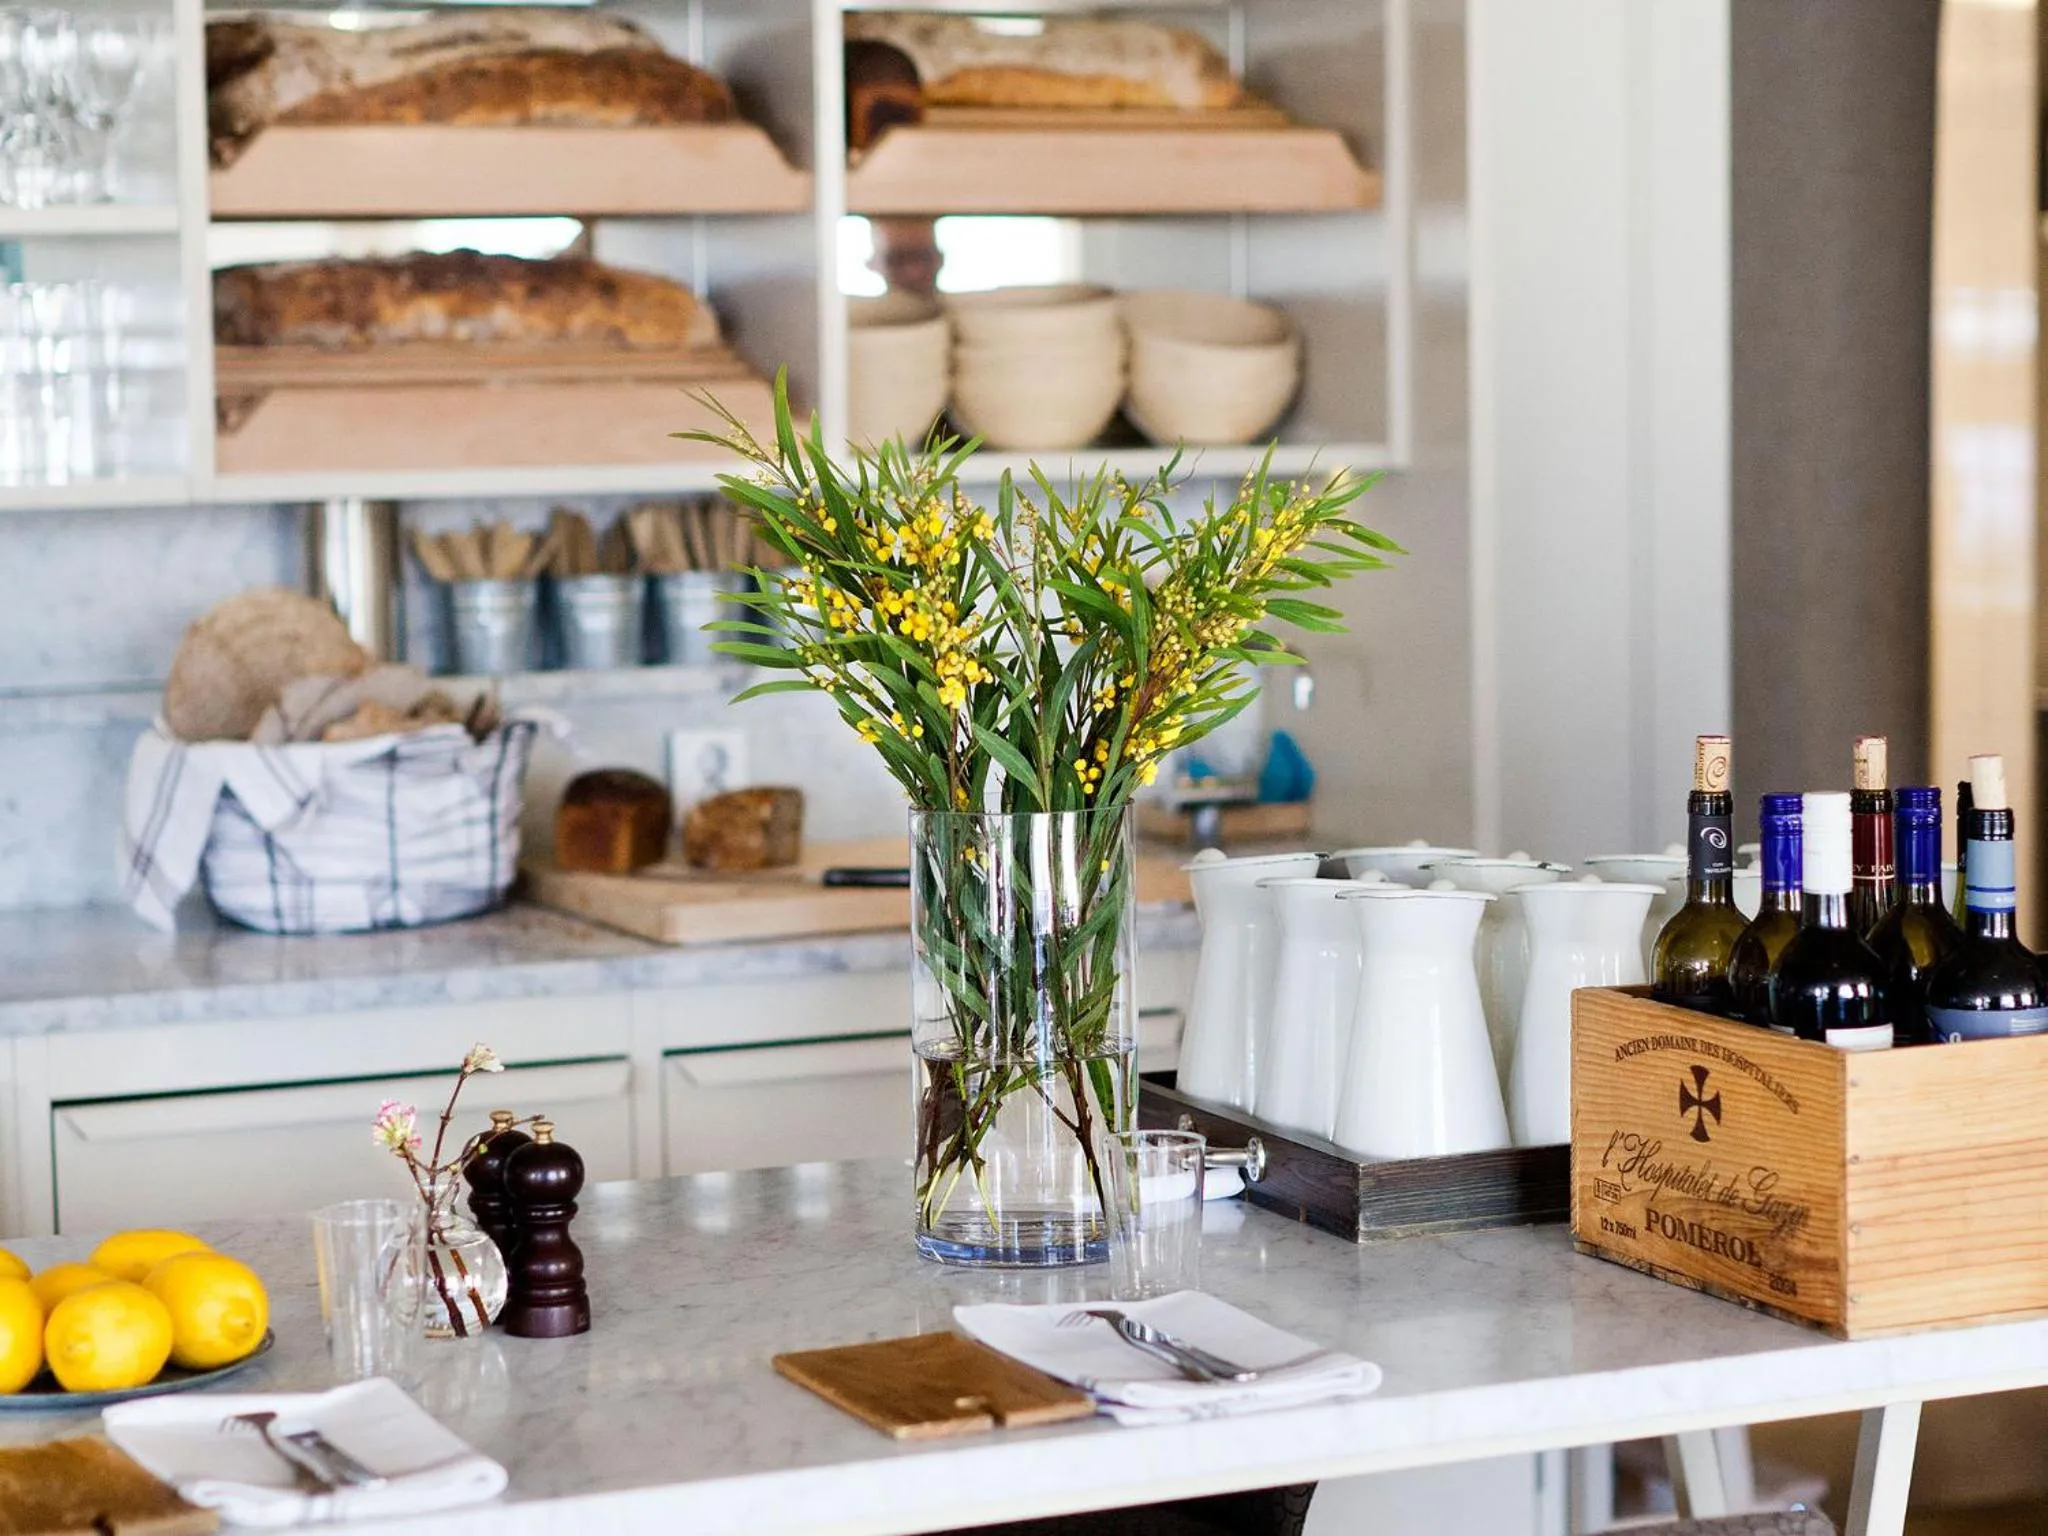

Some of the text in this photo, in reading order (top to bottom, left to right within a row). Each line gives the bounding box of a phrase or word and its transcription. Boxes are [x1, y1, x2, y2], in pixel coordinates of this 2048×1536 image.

[1615, 1037, 1649, 1063] ANCIEN
[1650, 1035, 1698, 1051] DOMAINE
[1700, 1040, 1720, 1059] DES
[1718, 1174, 1740, 1207] de
[1644, 1208, 1763, 1267] POMEROL
